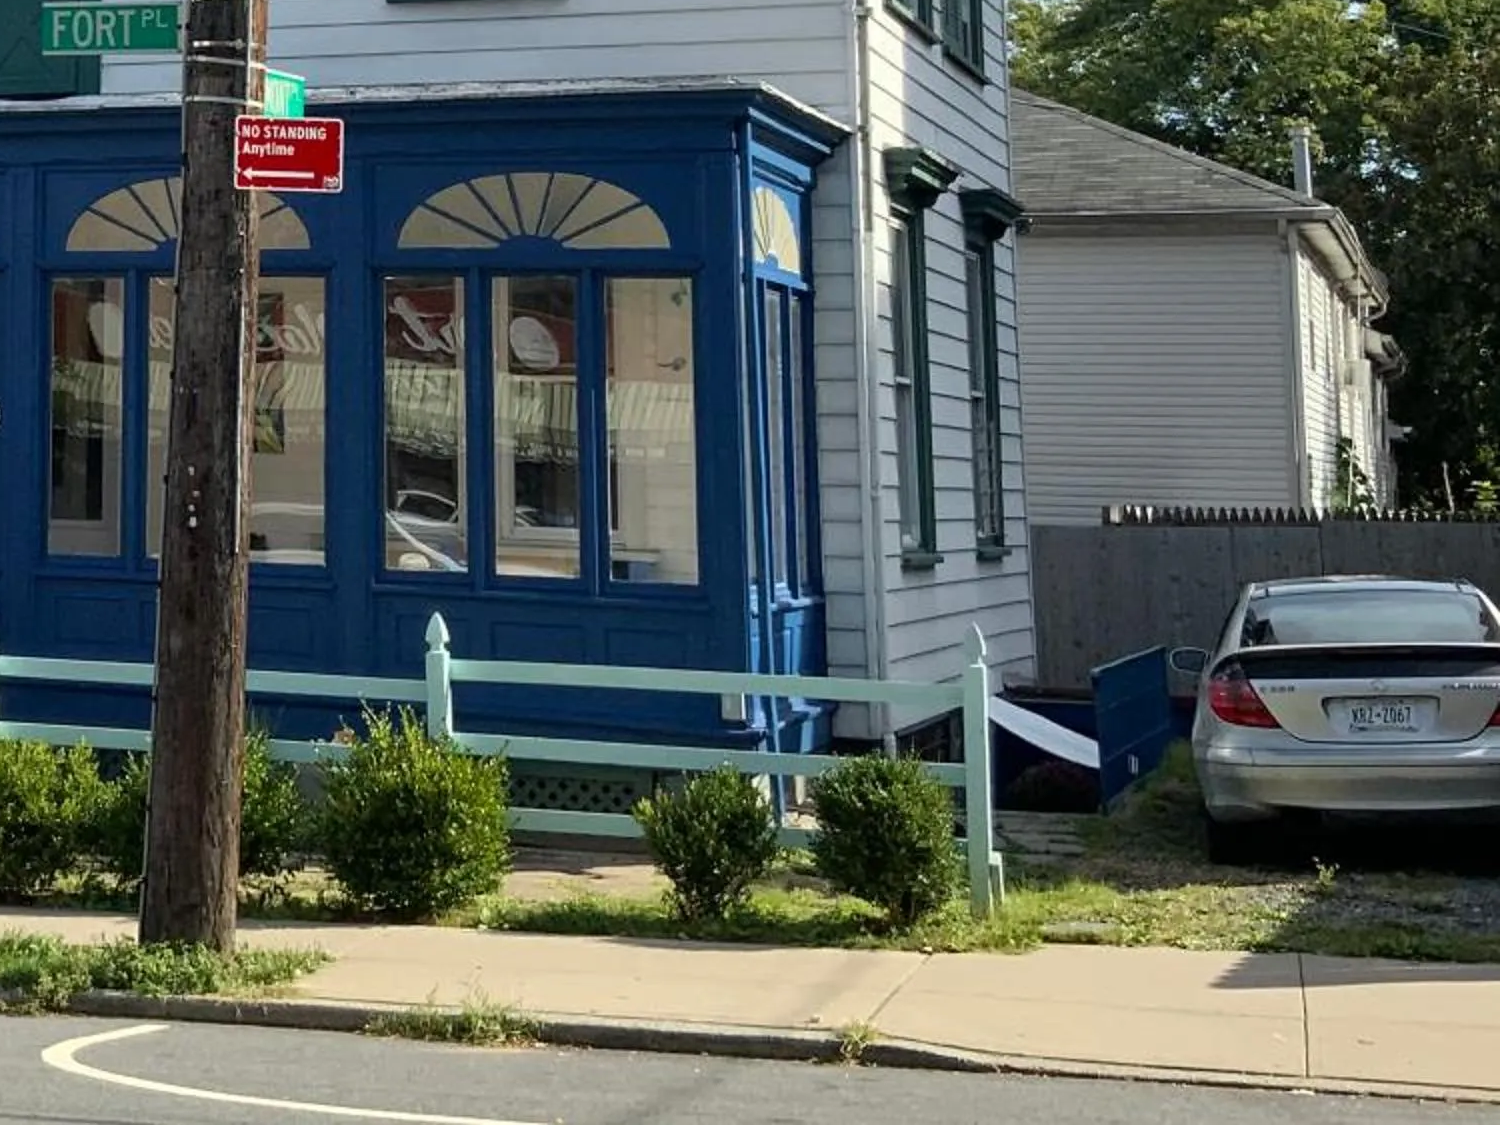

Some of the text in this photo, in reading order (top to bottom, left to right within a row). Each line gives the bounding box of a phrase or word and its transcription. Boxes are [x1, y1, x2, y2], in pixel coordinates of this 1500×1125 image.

[52, 8, 169, 48] FORT PL
[242, 124, 328, 141] NO STANDING
[242, 140, 296, 158] Anytime
